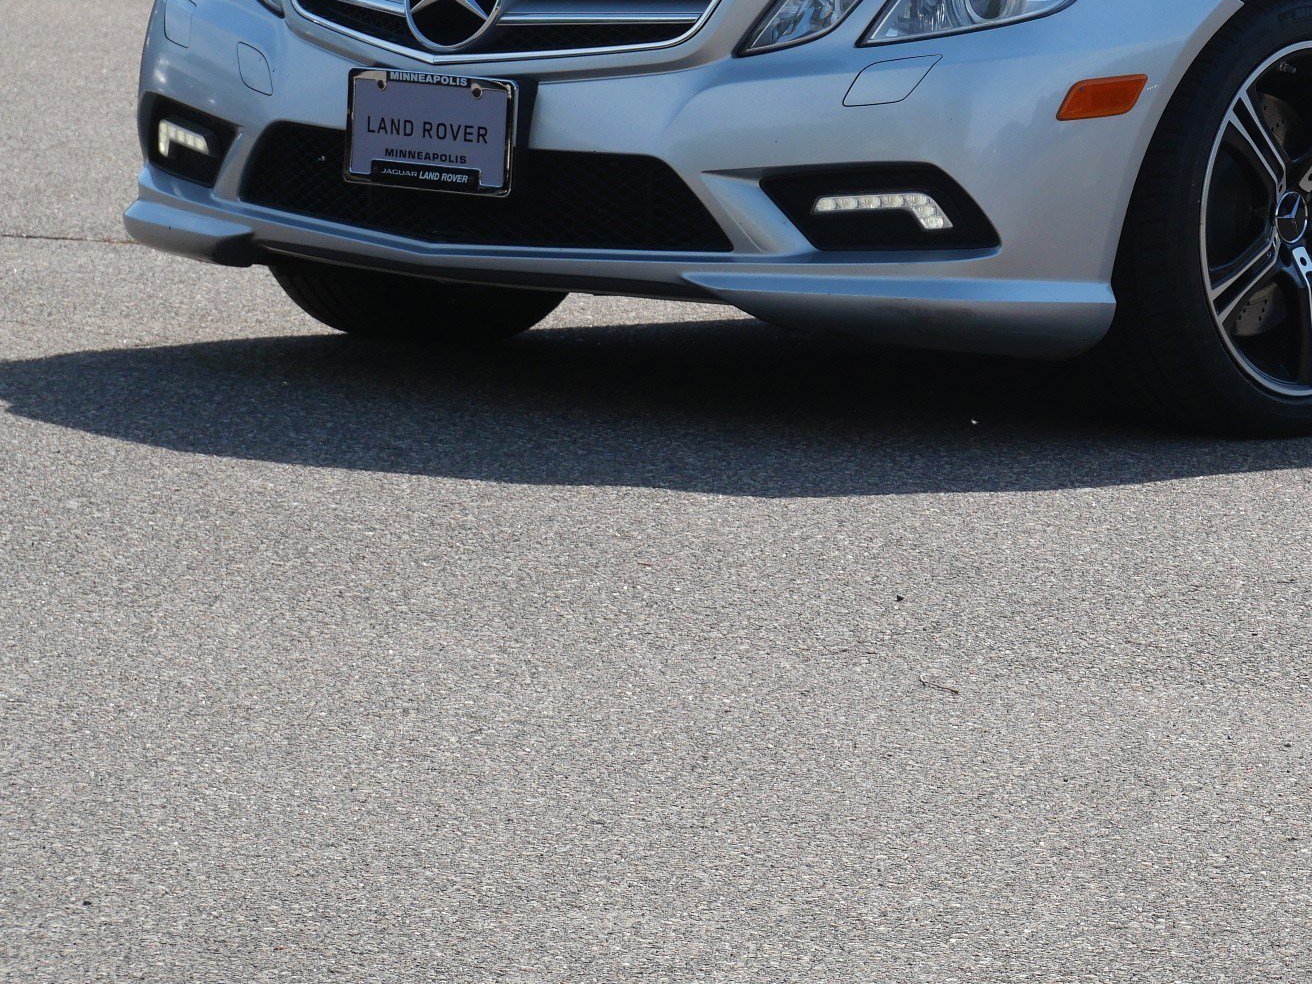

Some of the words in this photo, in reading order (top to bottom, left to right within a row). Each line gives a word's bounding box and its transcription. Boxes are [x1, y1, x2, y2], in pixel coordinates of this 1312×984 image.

[389, 71, 468, 87] MINNEAPOLIS
[367, 116, 414, 137] LAND
[422, 121, 488, 144] ROVER
[385, 148, 467, 164] MINNEAPOLIS
[381, 168, 418, 177] JAGUAR
[419, 171, 440, 181] LAND
[441, 173, 468, 184] ROVER
